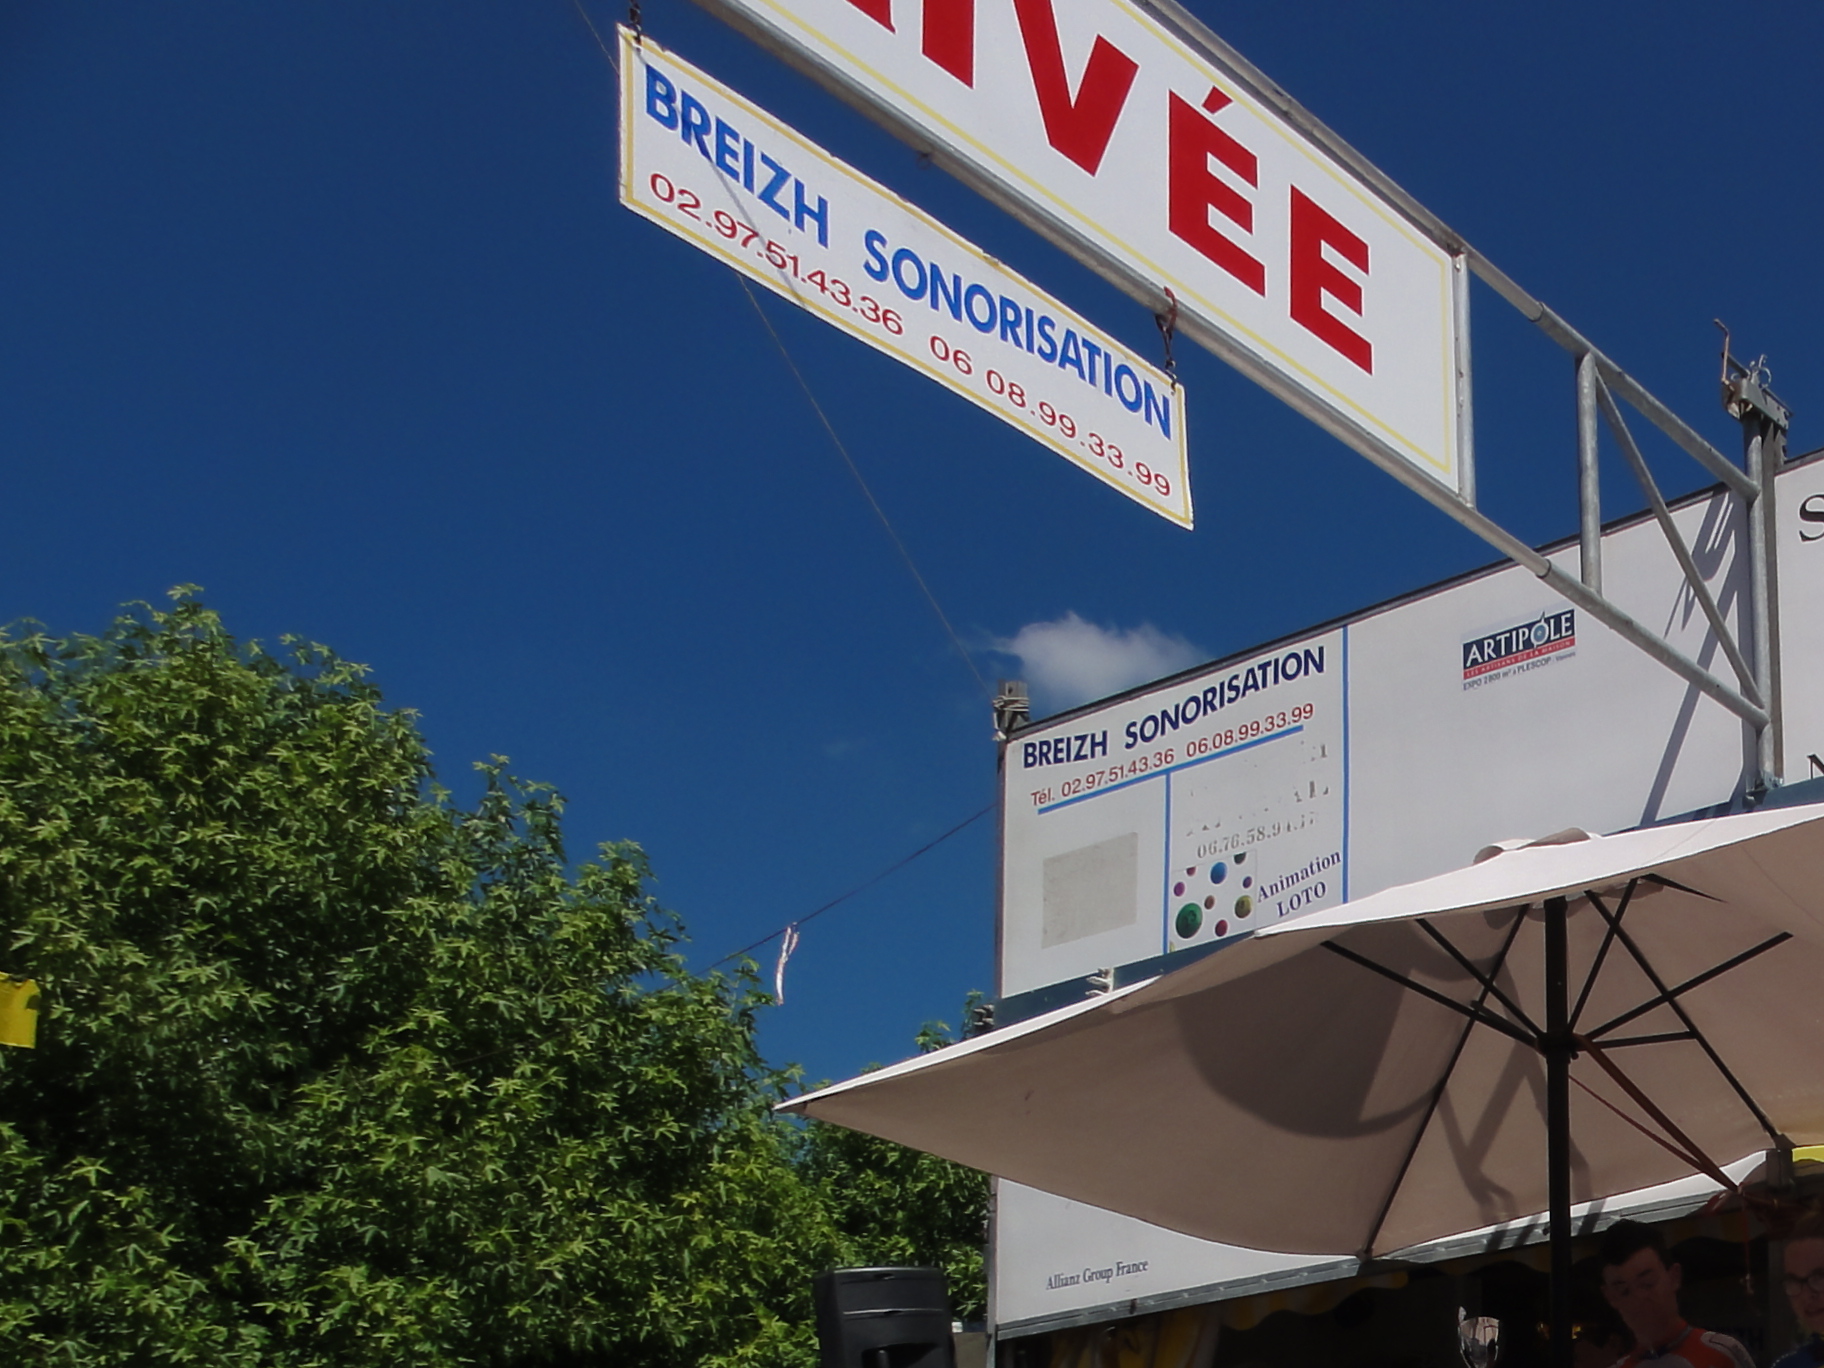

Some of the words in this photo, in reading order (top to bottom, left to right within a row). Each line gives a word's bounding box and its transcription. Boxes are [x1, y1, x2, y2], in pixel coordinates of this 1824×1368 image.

[643, 62, 830, 248] BREIZH
[861, 228, 1173, 441] SONORISATION
[649, 172, 904, 336] 02.97.51.43.36
[929, 334, 973, 377] 06
[1022, 730, 1108, 770] BREIZH
[1124, 645, 1326, 750] SONORISATION
[1463, 677, 1482, 691] EXPO
[1030, 785, 1055, 806] Tél.
[1060, 747, 1175, 798] 02.97.51.43.36
[1185, 703, 1314, 757] 06.08.99.33.99
[1257, 851, 1341, 903] Animation
[1277, 881, 1326, 918] LOTO
[1046, 1271, 1081, 1291] Allianz
[1083, 1266, 1114, 1287] Group
[1116, 1258, 1149, 1278] France
